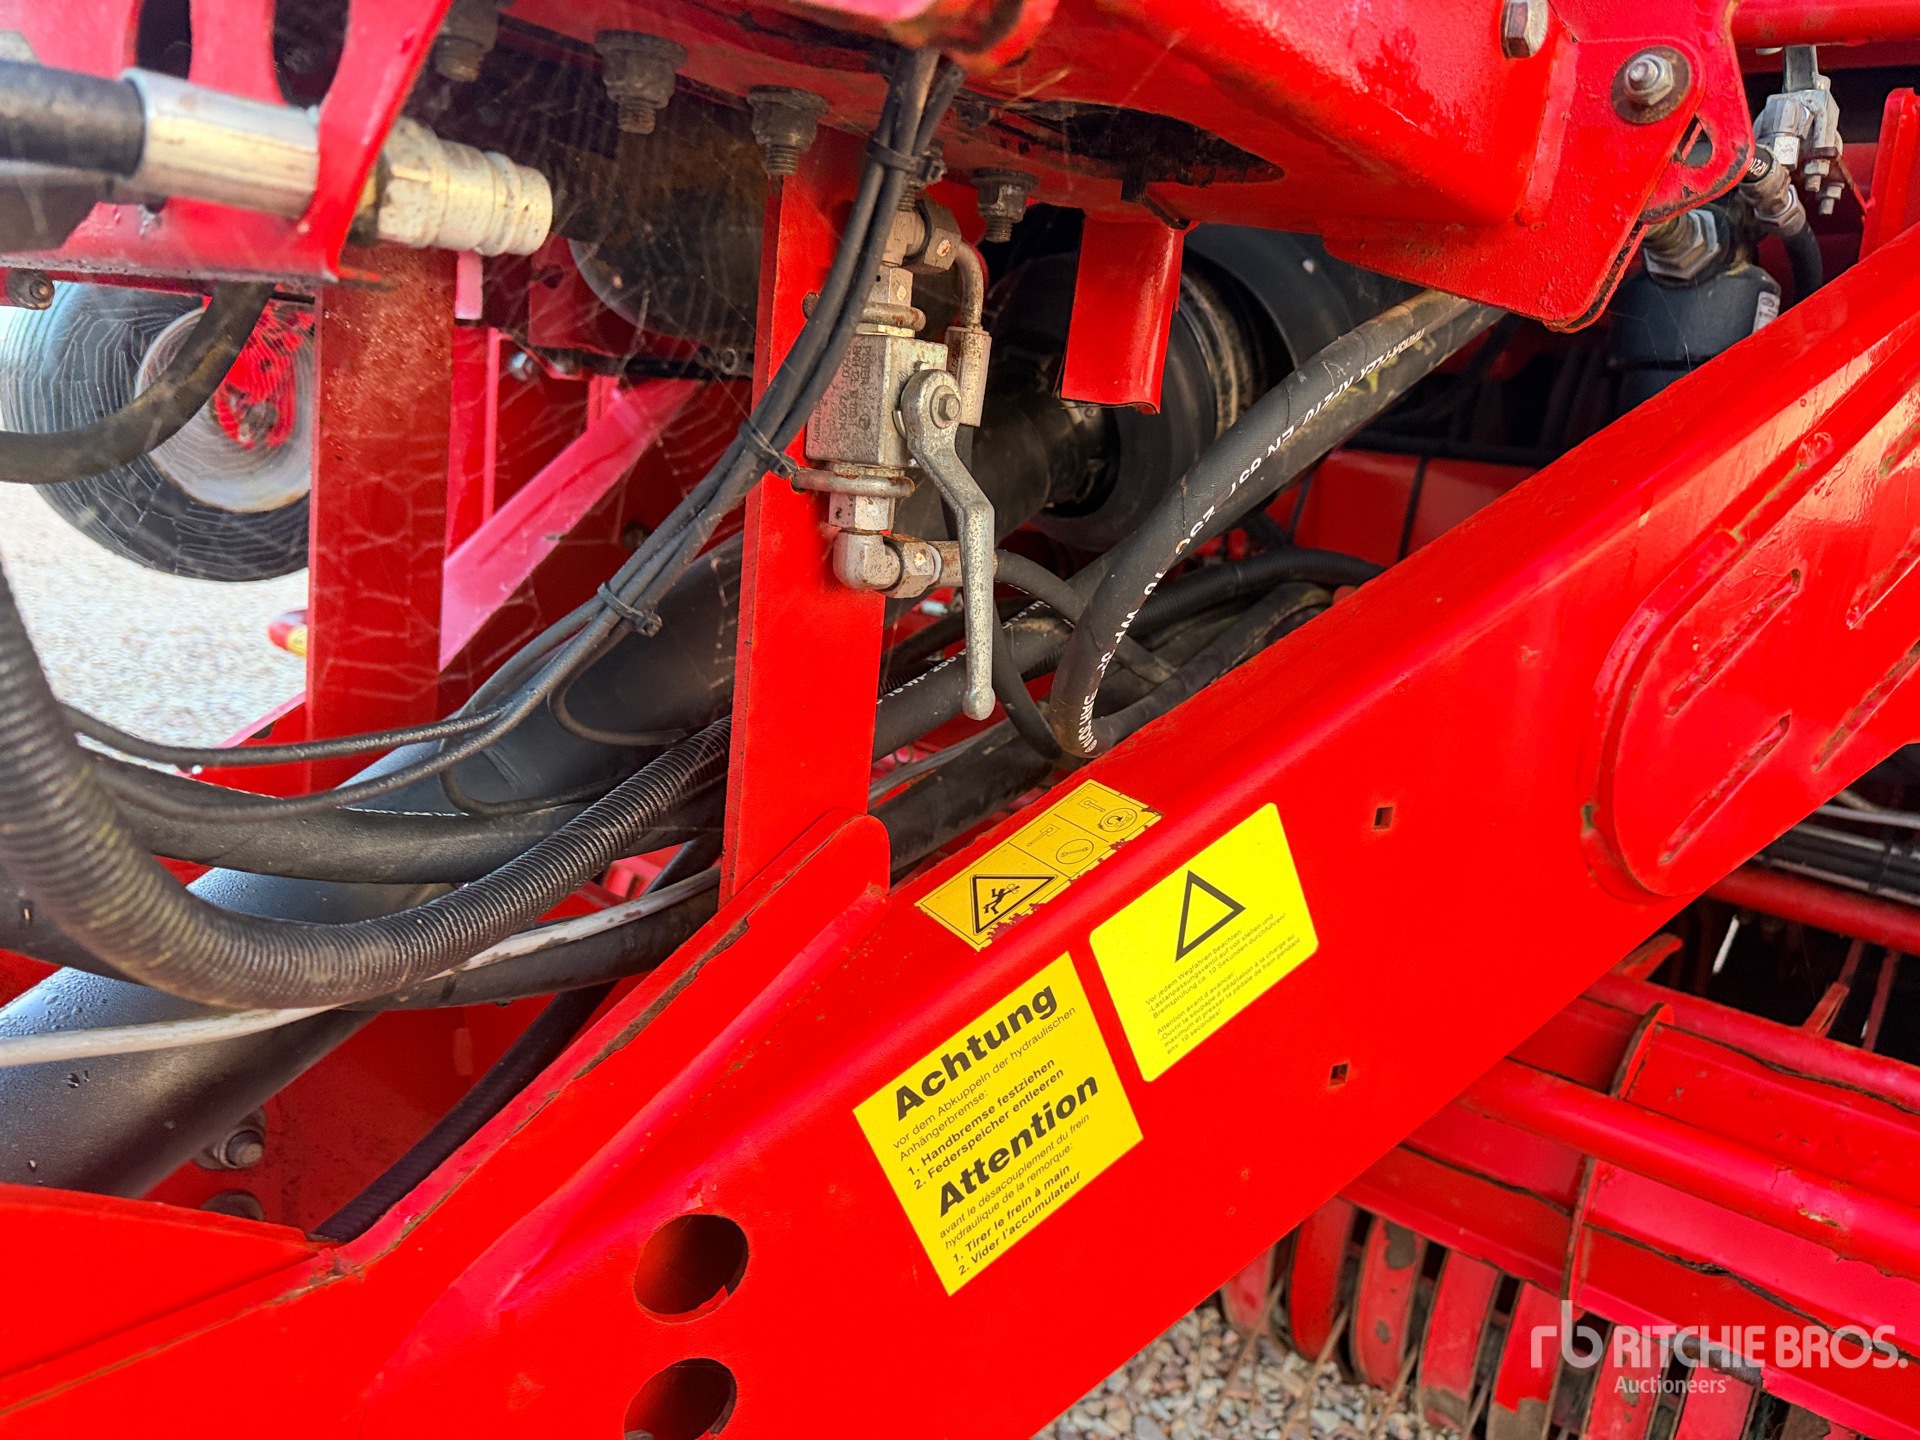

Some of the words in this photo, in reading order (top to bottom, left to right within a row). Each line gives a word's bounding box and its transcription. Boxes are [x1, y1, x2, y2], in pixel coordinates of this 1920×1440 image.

[860, 345, 872, 386] PISTER
[893, 1133, 909, 1148] vor
[912, 1114, 936, 1135] dem
[938, 1072, 991, 1116] Abkuppeln
[992, 1058, 1008, 1074] der
[1010, 1007, 1076, 1060] hydraulischen
[896, 985, 1058, 1122] Achtung
[900, 1090, 988, 1162] Anhängerbremse:
[907, 1166, 920, 1175] 1.
[921, 1106, 995, 1166] Handbremse
[997, 1059, 1055, 1107] festziehen
[914, 1179, 926, 1190] 2.
[927, 1111, 1009, 1179] Federspeicher
[1012, 1069, 1064, 1112] entleeren
[940, 1076, 1098, 1218] Attention
[940, 1213, 965, 1238] avant
[967, 1206, 976, 1216] le
[978, 1142, 1054, 1207] désacouplement
[1056, 1132, 1068, 1145] du
[1070, 1114, 1089, 1133] frein
[945, 1202, 1000, 1249] hydraulique
[1002, 1190, 1014, 1203] de
[1016, 1182, 1025, 1192] la
[1027, 1146, 1070, 1183] remorque:
[953, 1253, 963, 1262] 1.
[965, 1228, 991, 1252] Tirer
[994, 1218, 1004, 1230] le
[1007, 1196, 1032, 1220] frein
[1035, 1187, 1041, 1198] à
[1044, 1165, 1070, 1190] main
[958, 1264, 969, 1276] 2.
[971, 1237, 999, 1264] Vider
[1002, 1171, 1080, 1240] l'accumulateur
